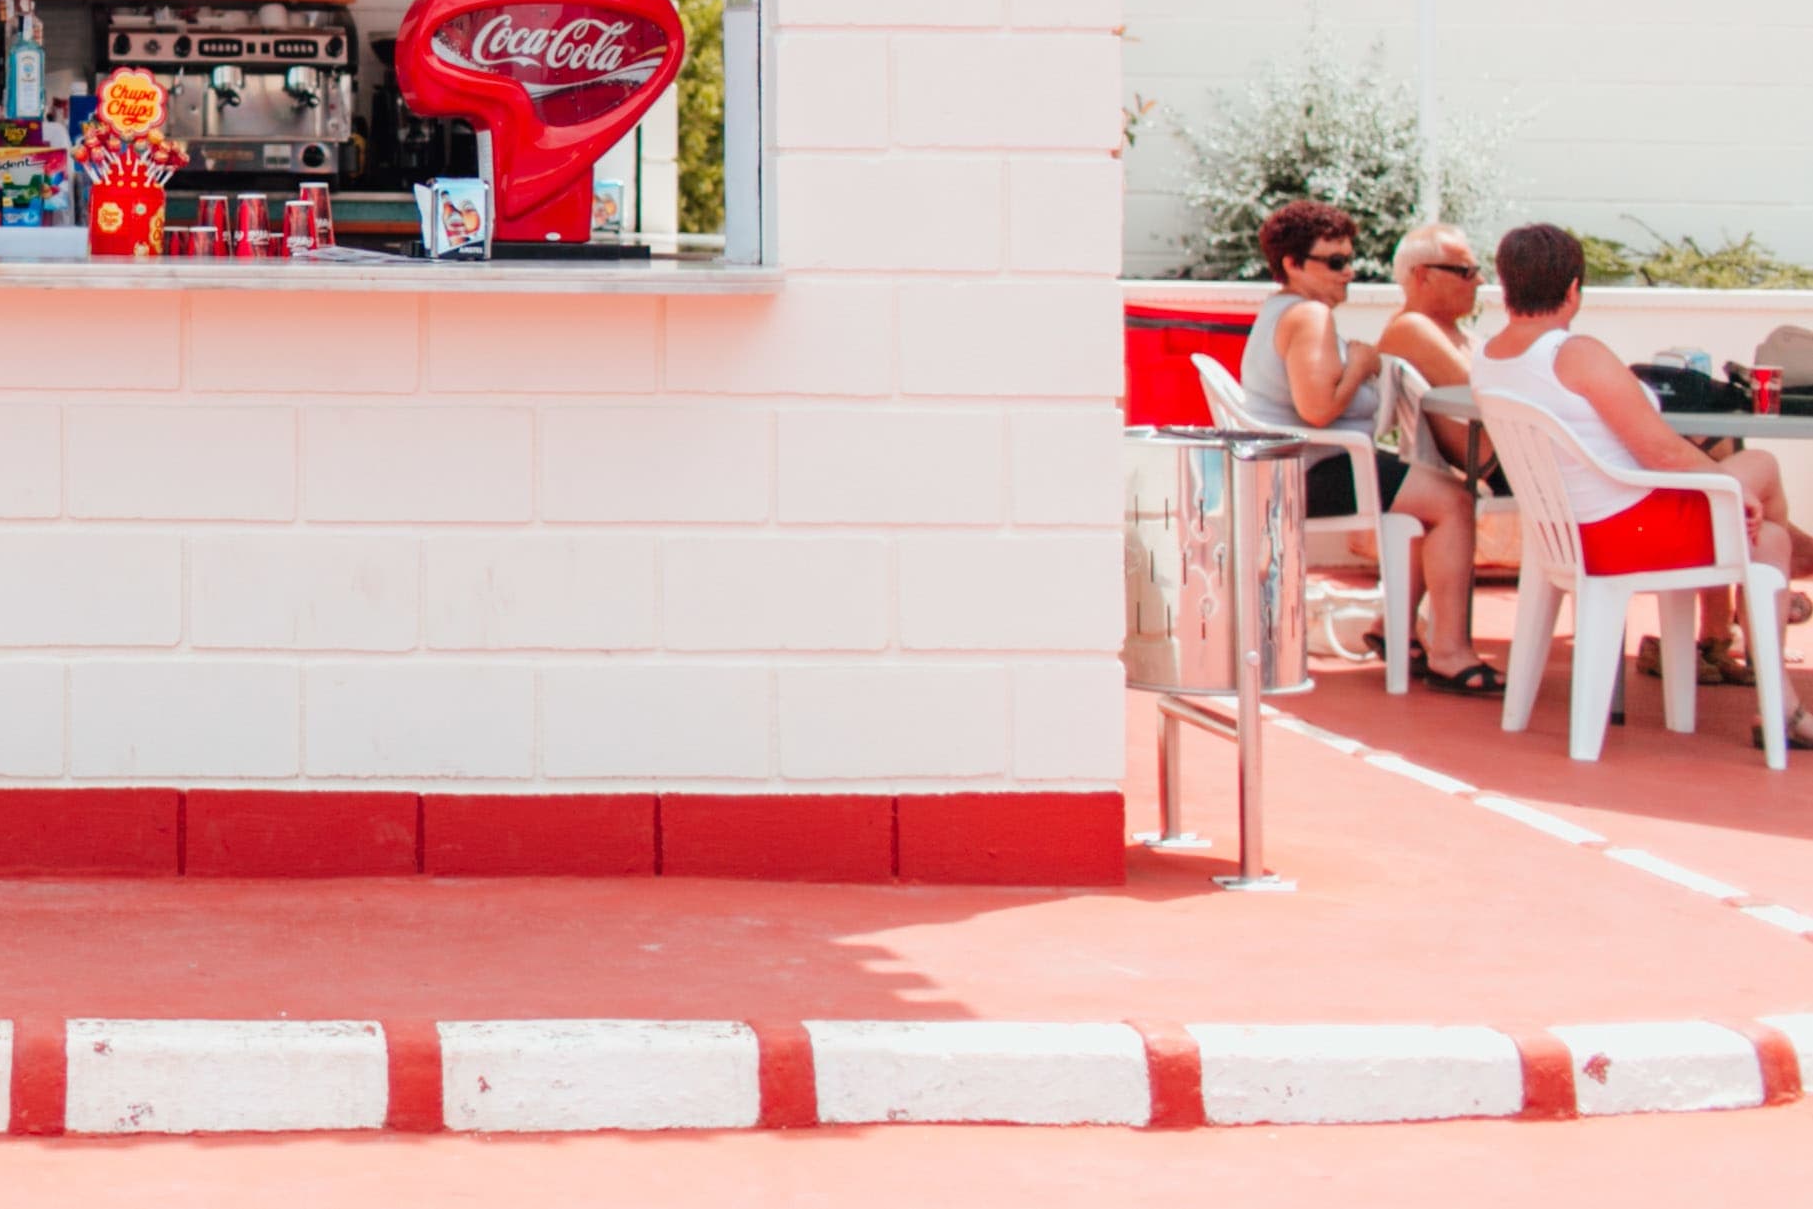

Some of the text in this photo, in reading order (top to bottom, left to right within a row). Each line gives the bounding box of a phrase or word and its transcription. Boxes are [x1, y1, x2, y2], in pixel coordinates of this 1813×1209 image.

[471, 14, 633, 70] Coca-Cola
[110, 84, 156, 104] Chupa
[107, 100, 154, 126] Chups
